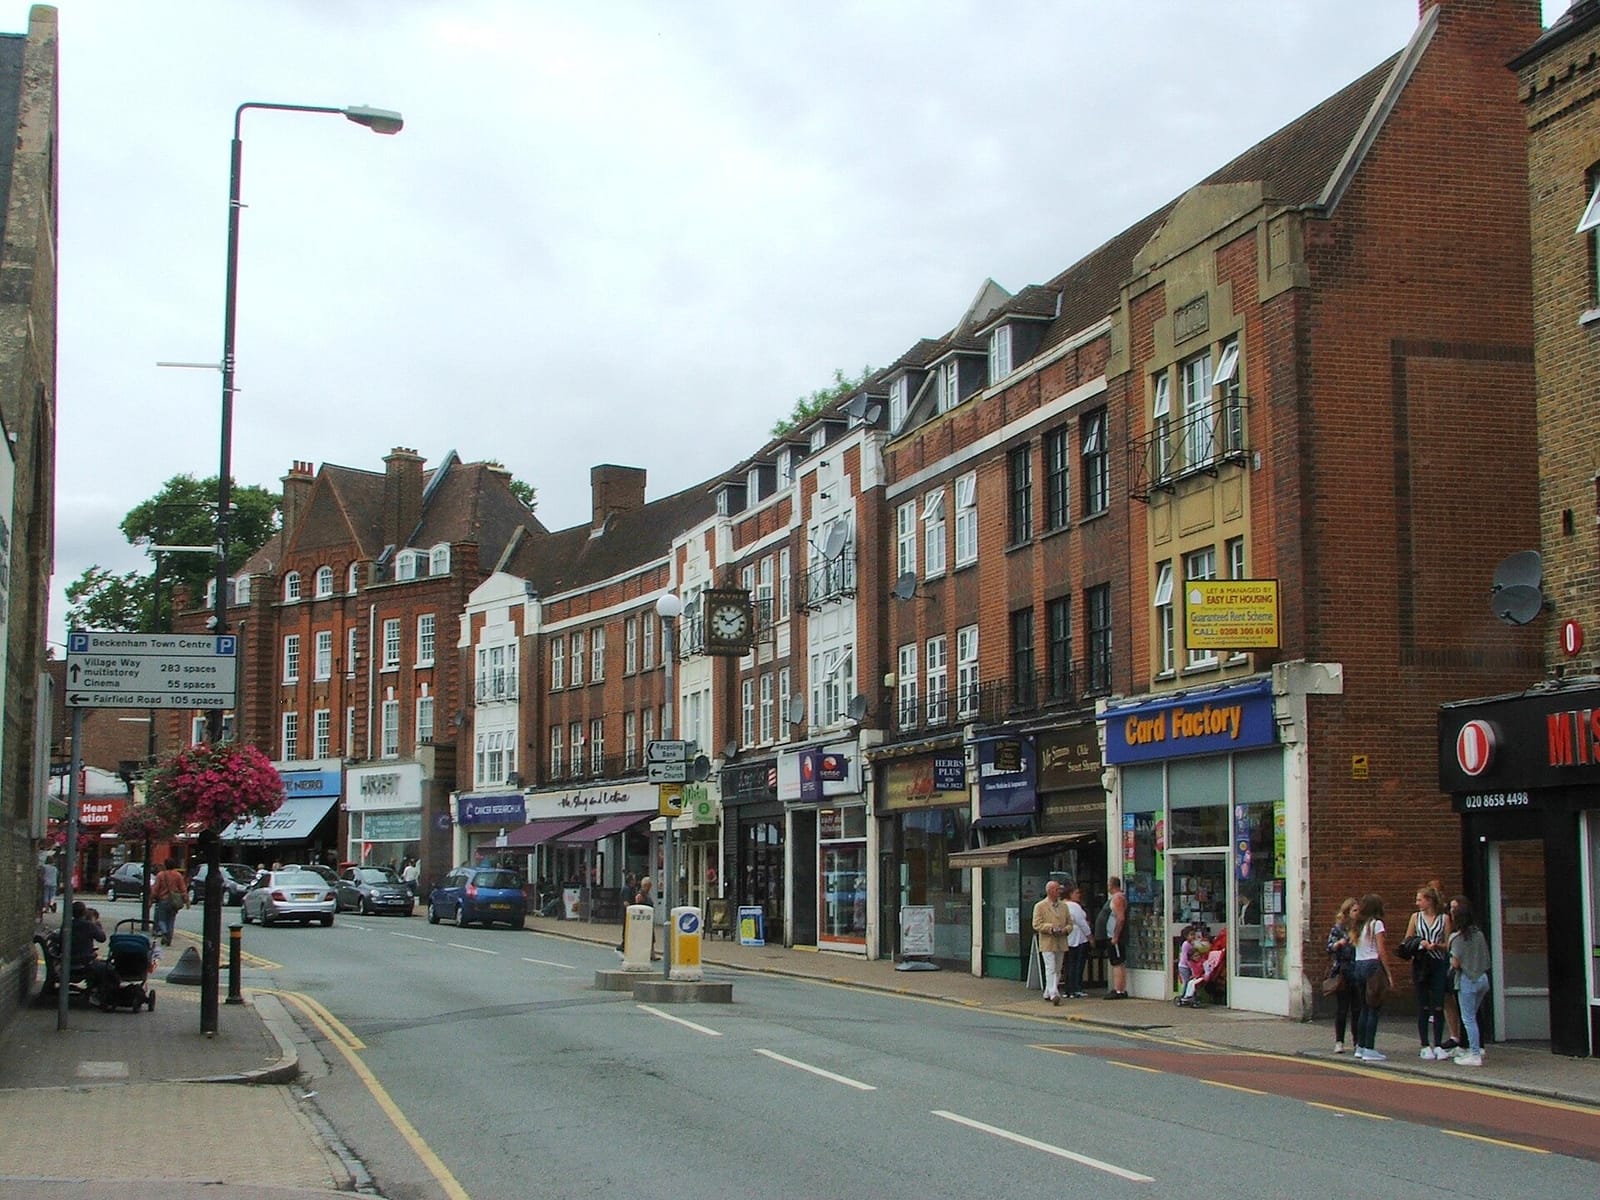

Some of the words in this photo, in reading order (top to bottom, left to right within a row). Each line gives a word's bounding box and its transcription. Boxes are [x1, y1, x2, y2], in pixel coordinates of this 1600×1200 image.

[1206, 595, 1224, 604] EASY
[1225, 595, 1238, 604] LET
[1240, 594, 1273, 604] HOUSING
[92, 638, 148, 647] Beckenham
[151, 640, 176, 648] Town
[179, 640, 212, 648] Centre
[84, 658, 117, 667] Village
[120, 659, 141, 668] Way
[160, 664, 181, 672] 283
[84, 668, 139, 678] multistorey
[84, 678, 120, 687] Cinema
[167, 680, 181, 688] 55
[93, 694, 134, 703] Fairfield
[136, 695, 162, 704] Road
[170, 696, 189, 704] 105
[1125, 711, 1166, 745] Card
[1171, 703, 1243, 739] Factory
[655, 743, 684, 751] Recycling
[935, 759, 964, 767] HERBS
[938, 768, 961, 776] PLUS
[1466, 796, 1482, 808] 020
[1483, 793, 1505, 807] 8658
[1506, 792, 1529, 805] 4498
[83, 804, 112, 813] Heart
